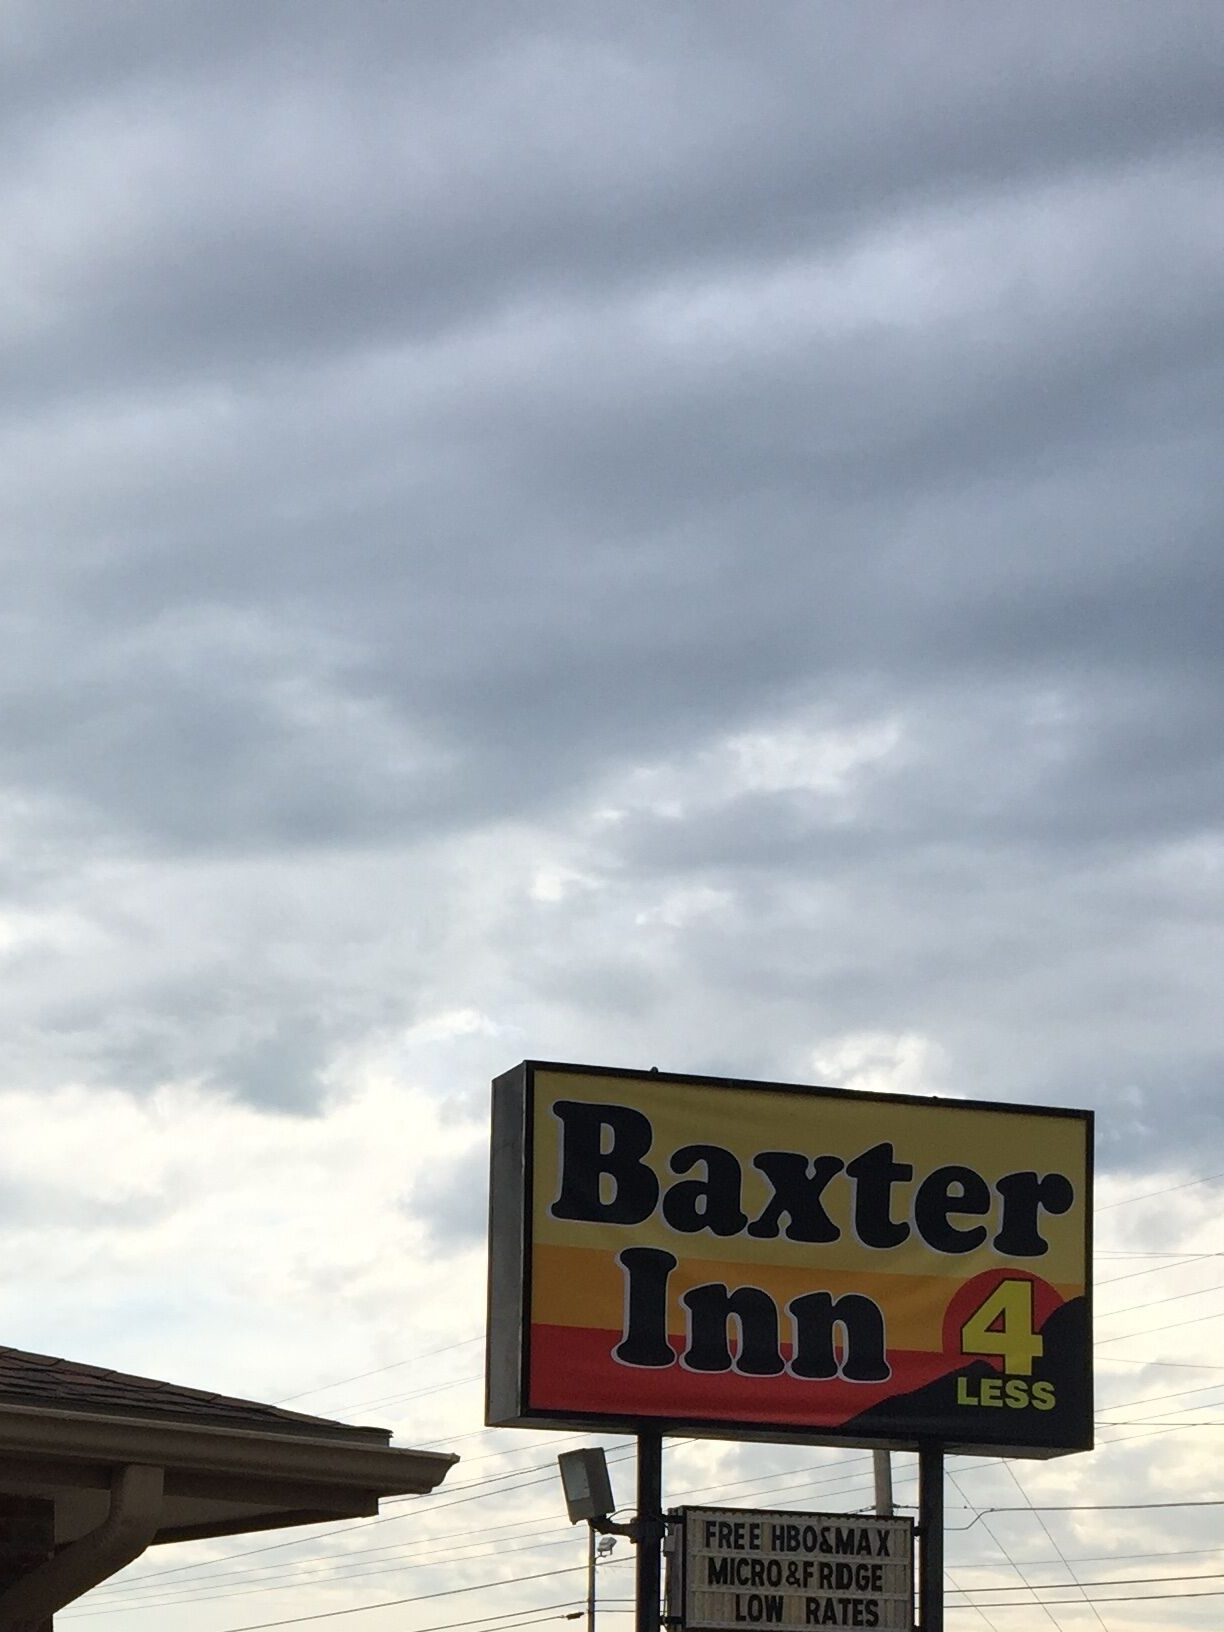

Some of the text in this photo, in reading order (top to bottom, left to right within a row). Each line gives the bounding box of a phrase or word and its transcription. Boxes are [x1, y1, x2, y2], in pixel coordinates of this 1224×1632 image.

[549, 1099, 1075, 1258] Baxter
[610, 1246, 893, 1384] Inn
[960, 1278, 1045, 1378] 4
[956, 1376, 1057, 1412] LESS
[704, 1520, 761, 1550] FREE
[734, 1594, 785, 1623] LOW
[805, 1597, 880, 1628] RATES
